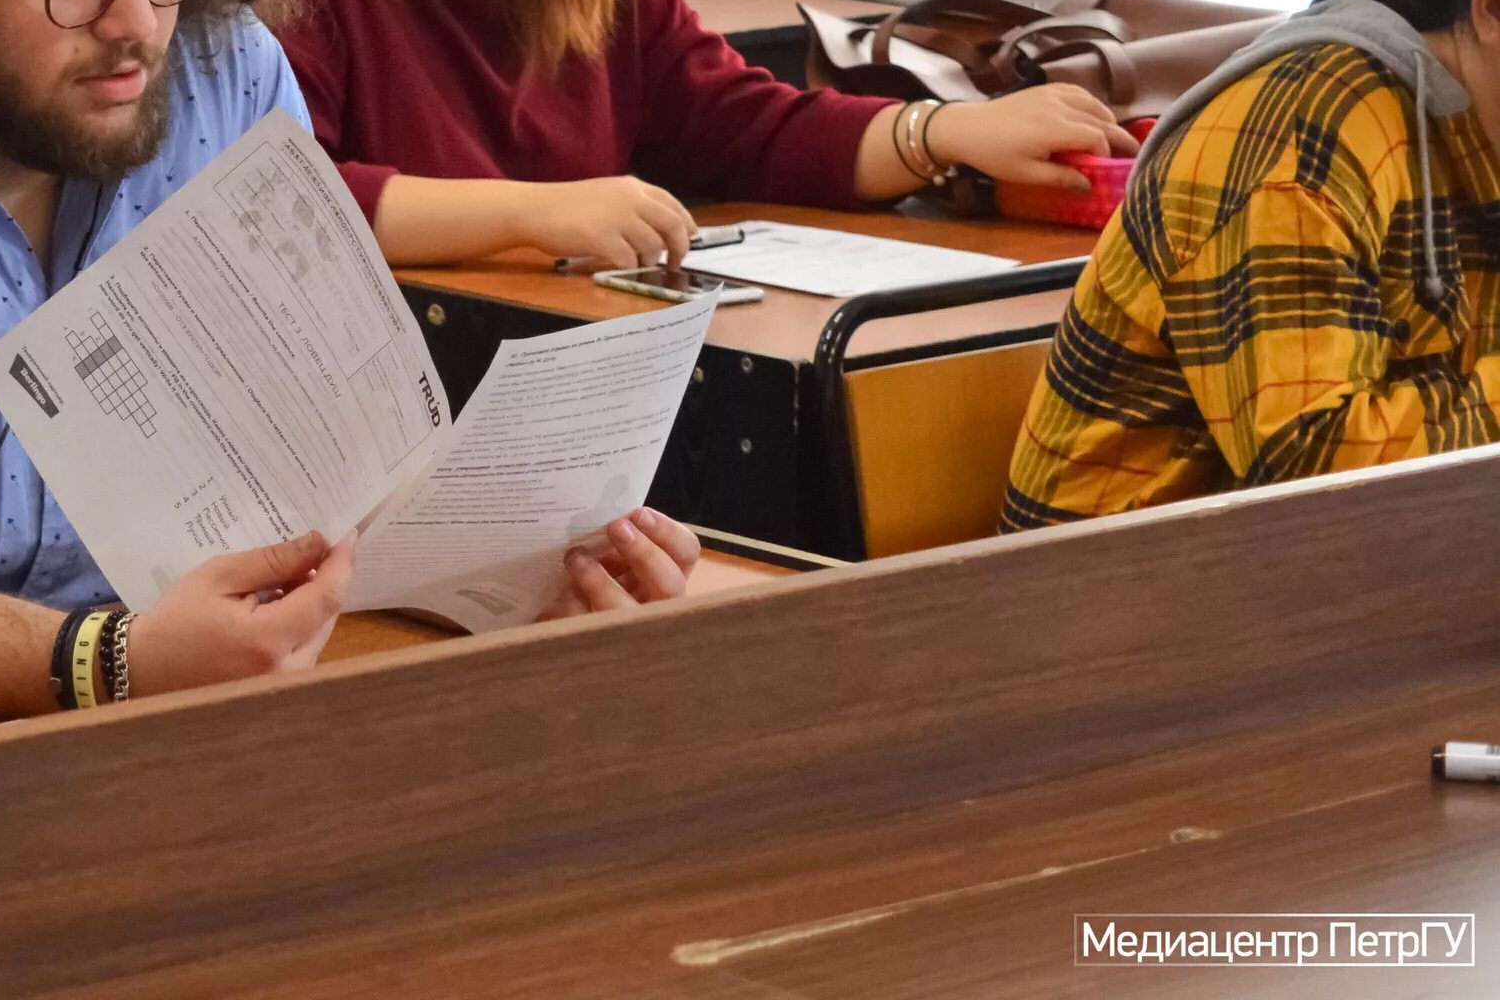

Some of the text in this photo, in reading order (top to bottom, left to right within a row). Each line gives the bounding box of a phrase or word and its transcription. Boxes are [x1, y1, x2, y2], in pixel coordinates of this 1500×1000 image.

[139, 250, 149, 262] the
[251, 296, 270, 320] Rewrite
[267, 319, 277, 331] the
[107, 295, 120, 312] word
[117, 310, 126, 320] do
[122, 319, 133, 331] you
[130, 330, 141, 342] get
[137, 340, 161, 371] vertically?
[158, 369, 173, 387] Write
[276, 301, 297, 326] ТЕСТ
[299, 335, 328, 373] ЛОВЕЦ
[322, 371, 343, 399] ДУШ
[17, 366, 48, 405] Berlingo
[113, 281, 140, 315] Подберите
[136, 314, 160, 345] антонимы
[210, 418, 226, 438] Какое
[223, 436, 239, 456] слово
[104, 279, 128, 311] Напишите
[170, 372, 180, 383] Fill
[181, 388, 191, 400] the
[188, 399, 212, 430] crossword
[209, 428, 221, 443] with
[218, 441, 229, 453] the
[224, 452, 248, 482] antonyms
[250, 487, 260, 499] the
[256, 498, 271, 516] given
[245, 387, 267, 414] Displace
[264, 412, 274, 424] the
[271, 422, 288, 444] letters
[285, 443, 296, 456] and
[293, 454, 307, 472] write
[304, 470, 319, 489] down
[201, 506, 232, 551] Пессимист
[210, 500, 231, 530] Новый
[218, 493, 240, 524] Умный
[185, 519, 205, 549] Лучше
